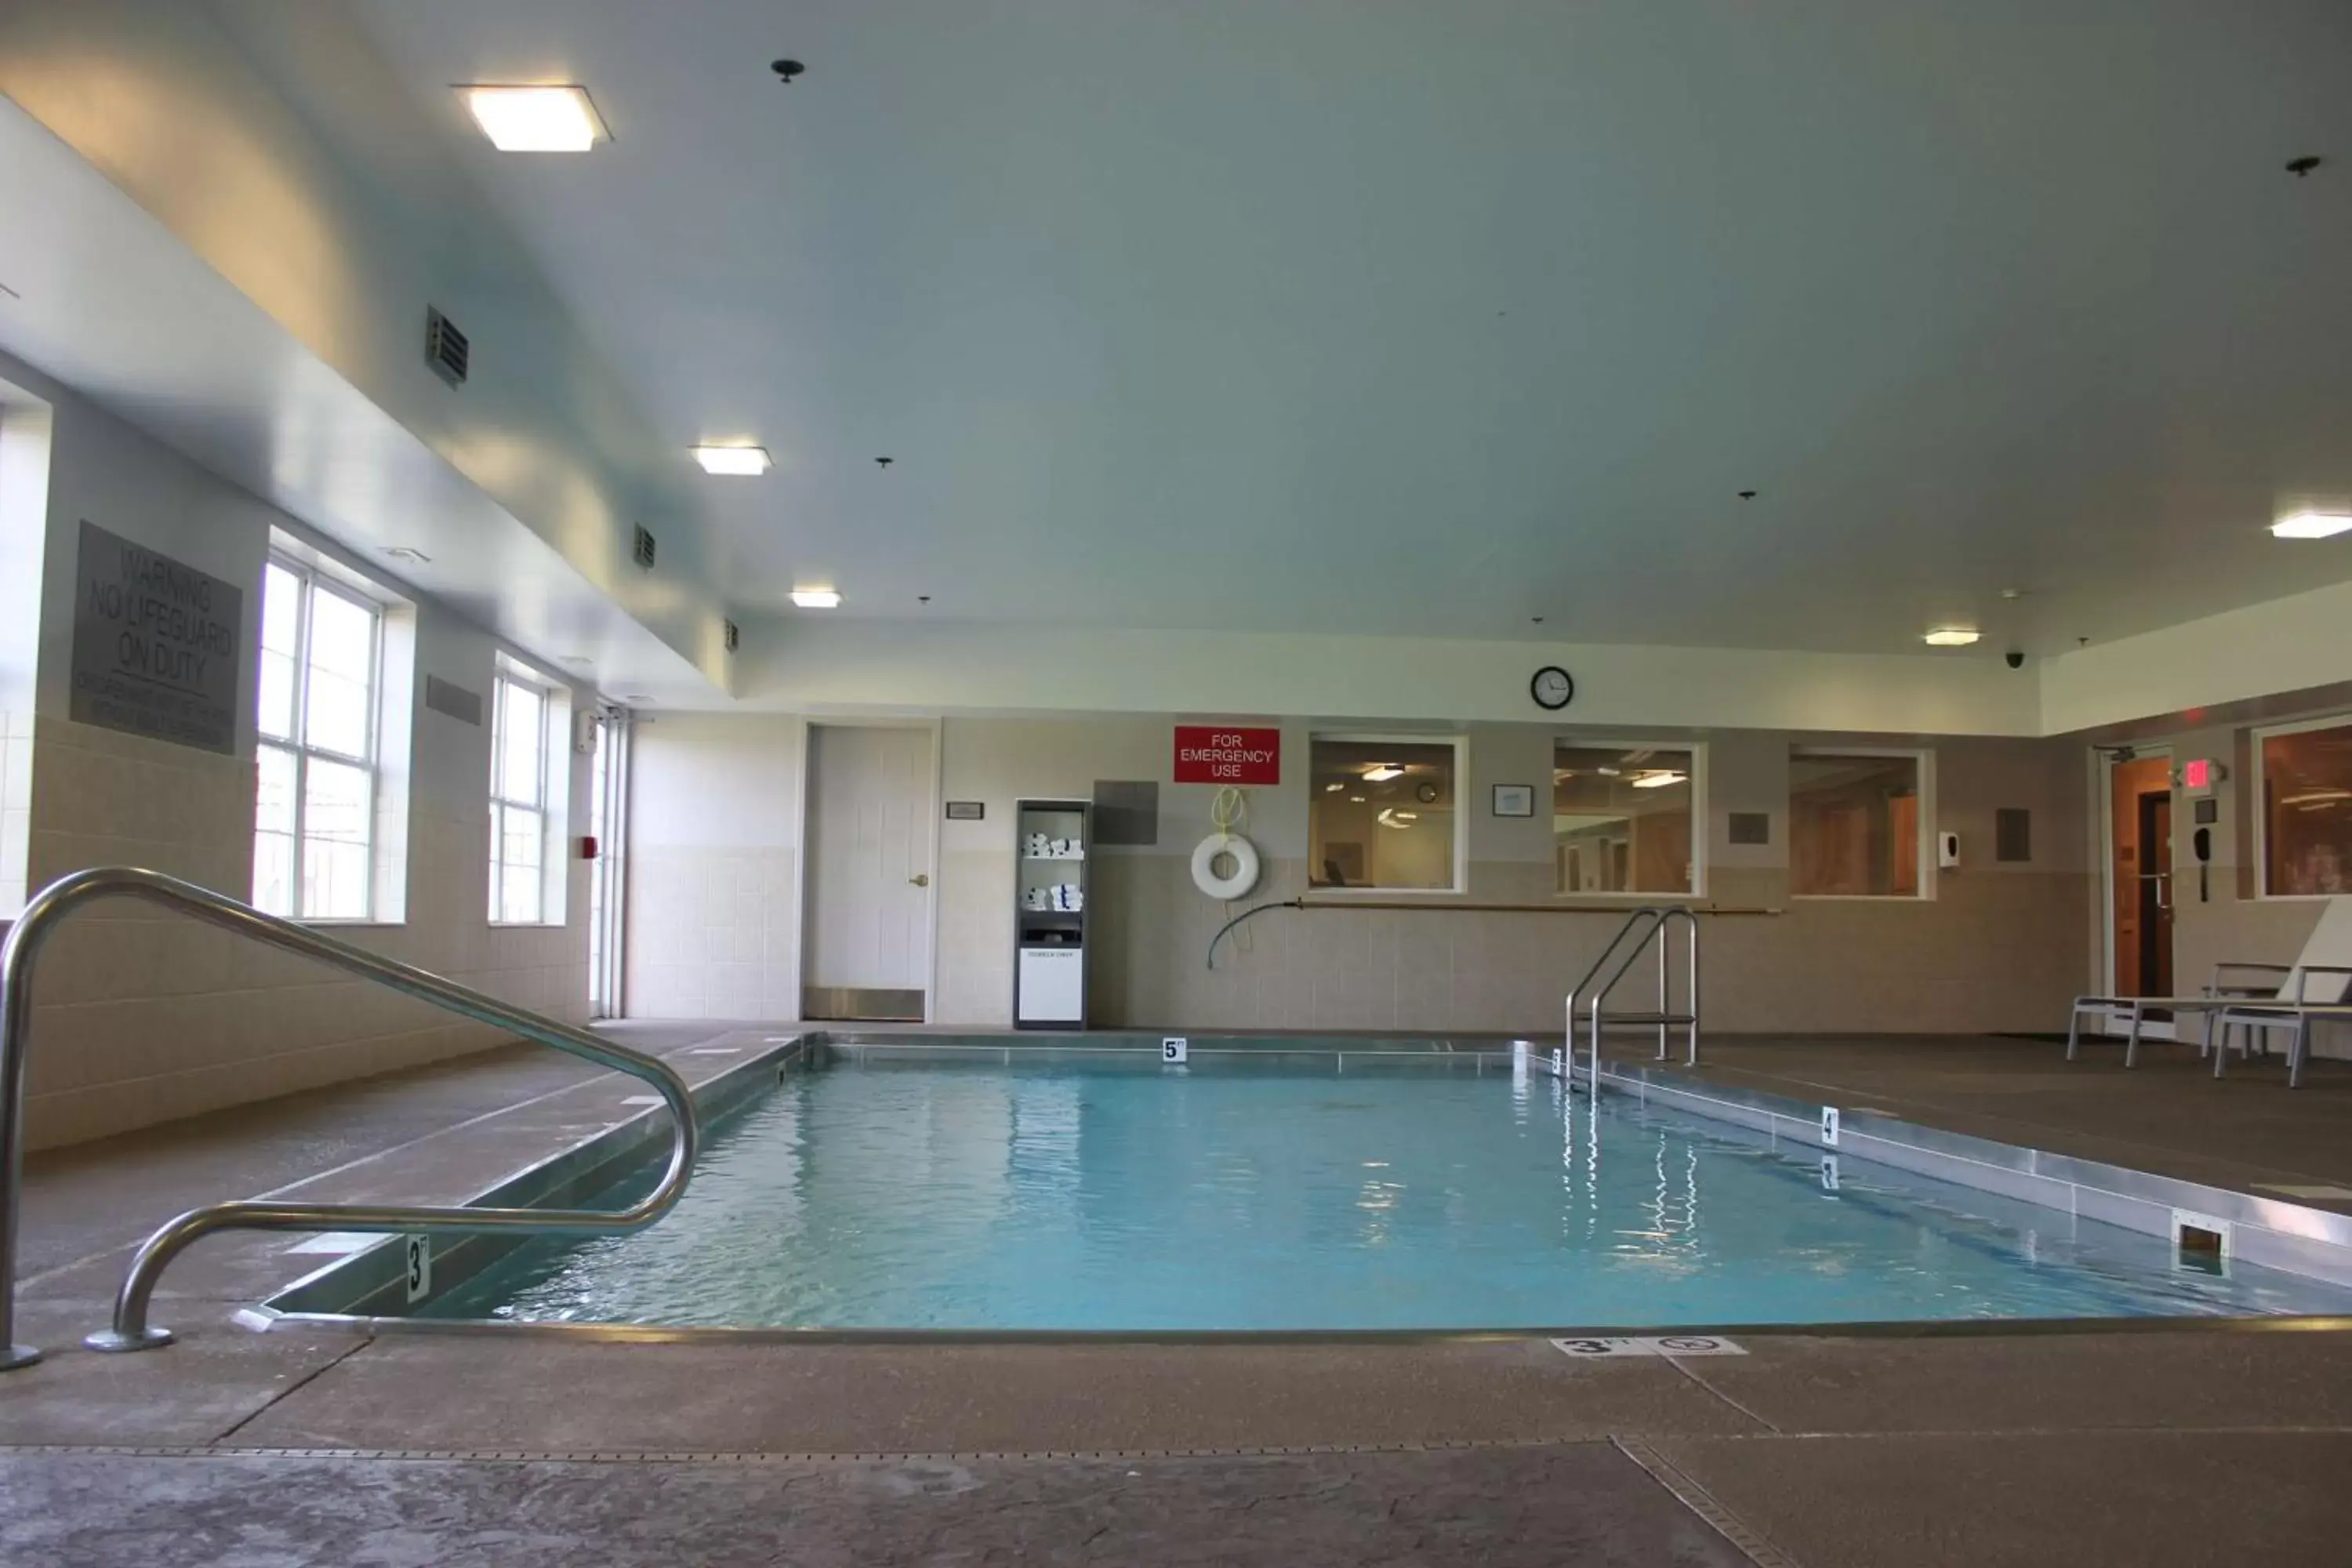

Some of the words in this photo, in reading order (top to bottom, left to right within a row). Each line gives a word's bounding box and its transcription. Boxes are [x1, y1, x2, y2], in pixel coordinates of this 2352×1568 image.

[89, 578, 122, 620] NO
[126, 593, 232, 658] LIFEGUARD
[118, 630, 150, 673] ON
[154, 642, 208, 684] DUTY
[1211, 734, 1243, 748] FOR
[1180, 748, 1274, 764] EMERGENCY
[1211, 764, 1243, 778] USE
[1165, 1040, 1178, 1058] 5
[1824, 1112, 1832, 1139] 4
[409, 1241, 422, 1292] 3
[1563, 1339, 1613, 1354] 3
